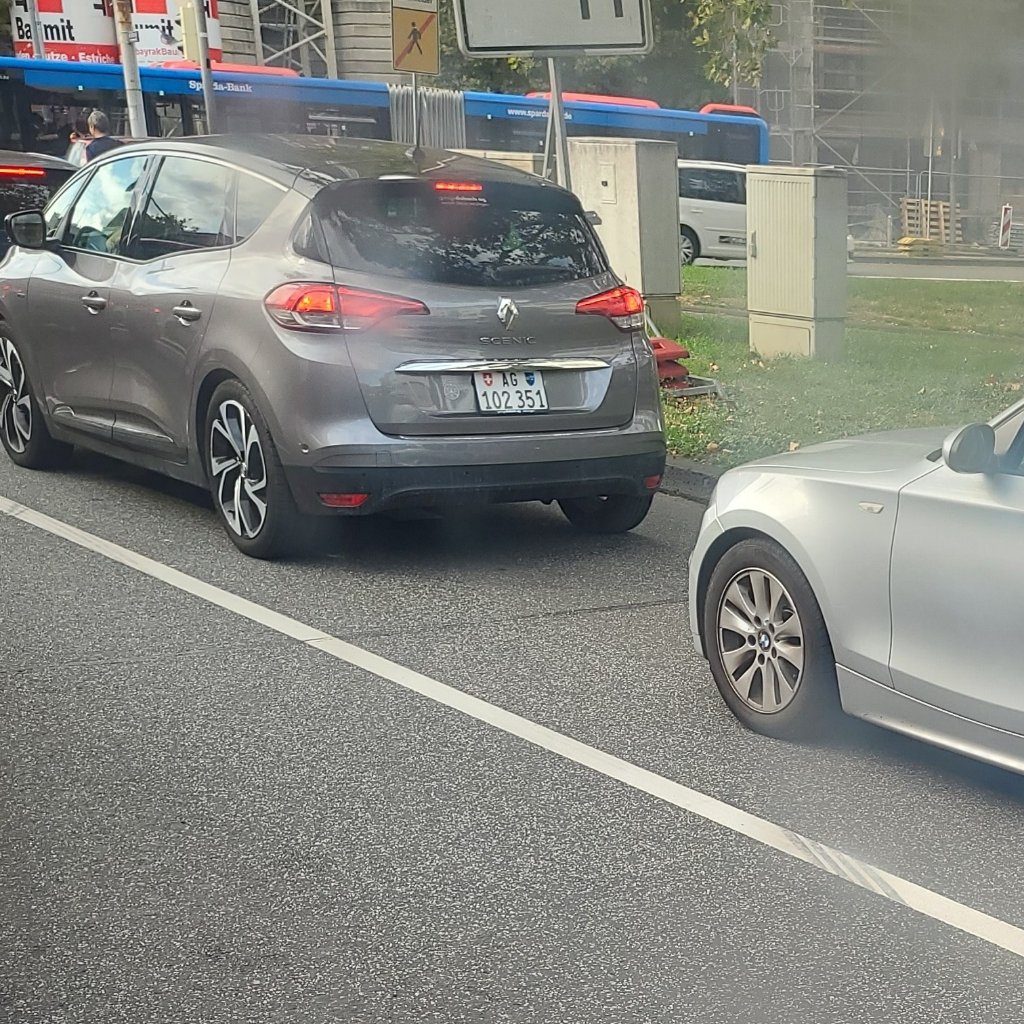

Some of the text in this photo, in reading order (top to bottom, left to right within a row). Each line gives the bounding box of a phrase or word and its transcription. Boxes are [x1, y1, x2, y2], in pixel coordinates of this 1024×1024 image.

[15, 17, 75, 41] Bamit
[188, 80, 253, 93] Spda-Bank
[479, 336, 537, 345] SCENIC
[502, 372, 518, 387] AG
[481, 389, 545, 409] 102 351
